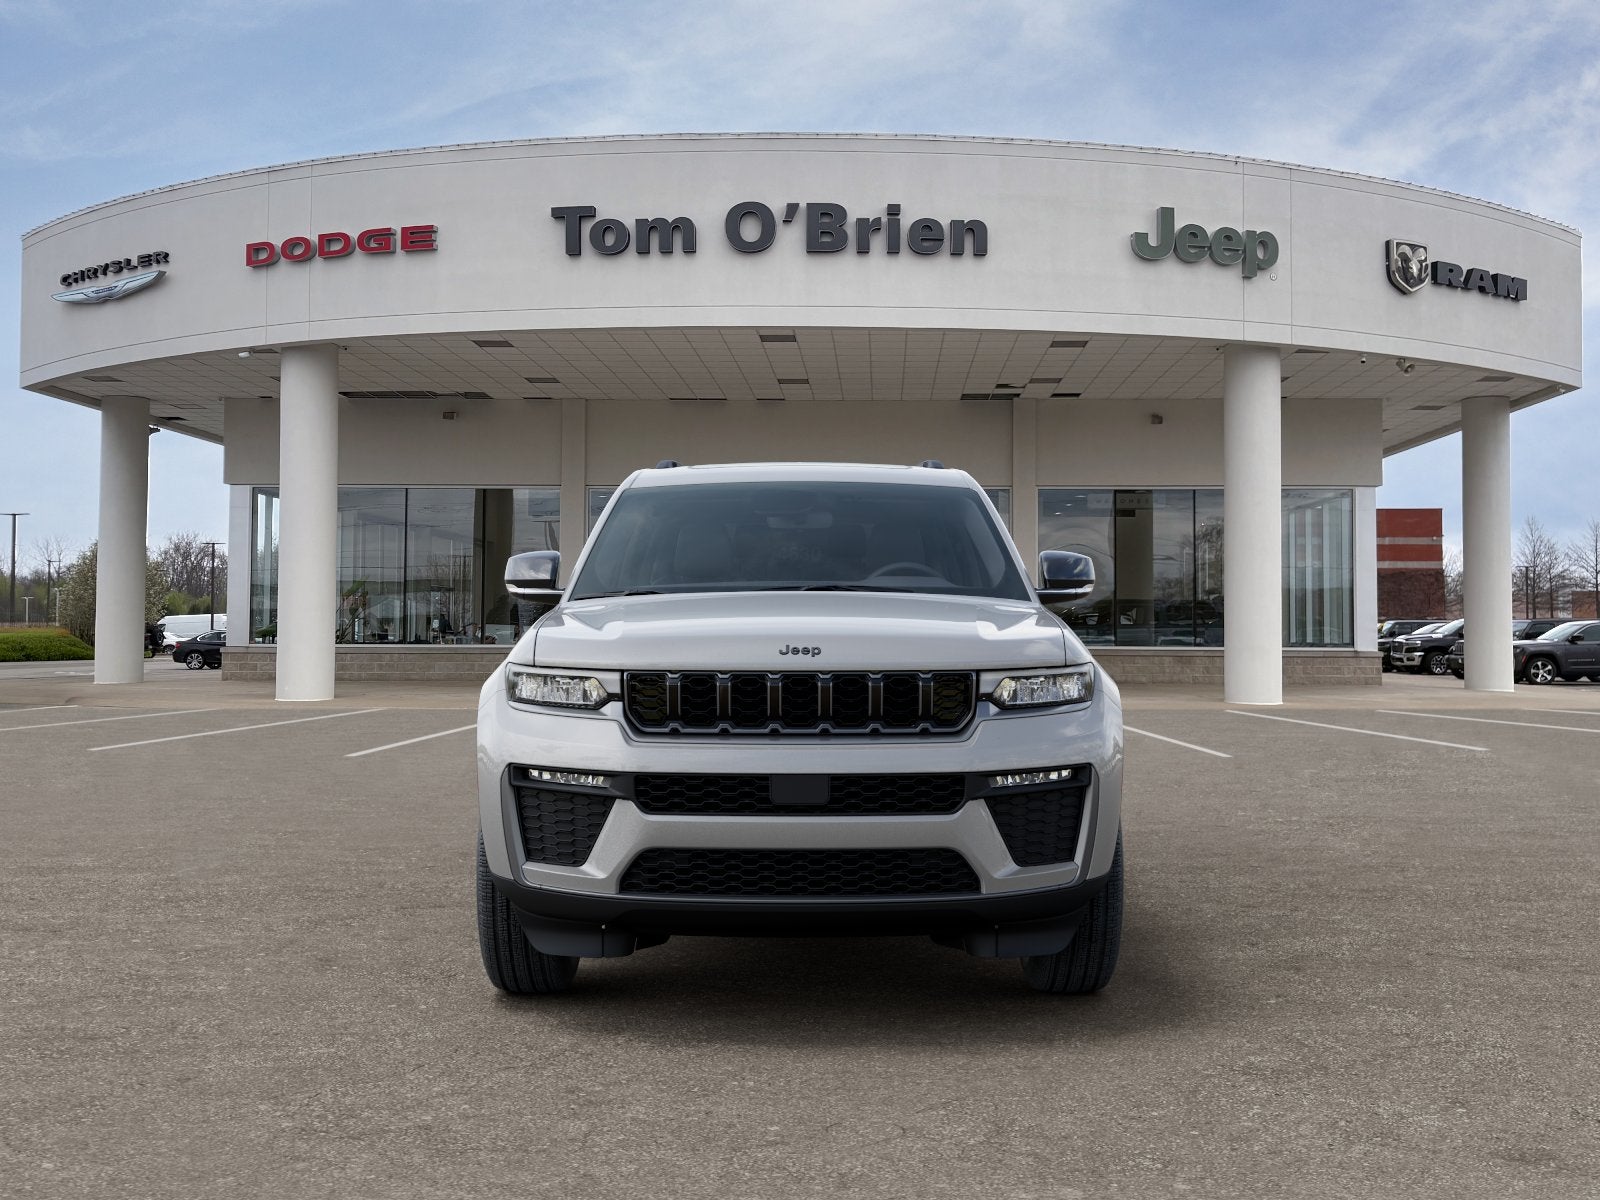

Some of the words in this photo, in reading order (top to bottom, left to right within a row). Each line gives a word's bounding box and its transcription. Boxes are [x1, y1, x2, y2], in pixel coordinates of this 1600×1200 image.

[245, 225, 438, 268] DODGE
[551, 205, 697, 256] Tom
[725, 201, 989, 256] O'Brien
[1131, 207, 1279, 279] Jeep
[59, 251, 169, 286] CHRYSLER
[1430, 260, 1528, 301] RAM
[778, 644, 822, 658] Jeep
